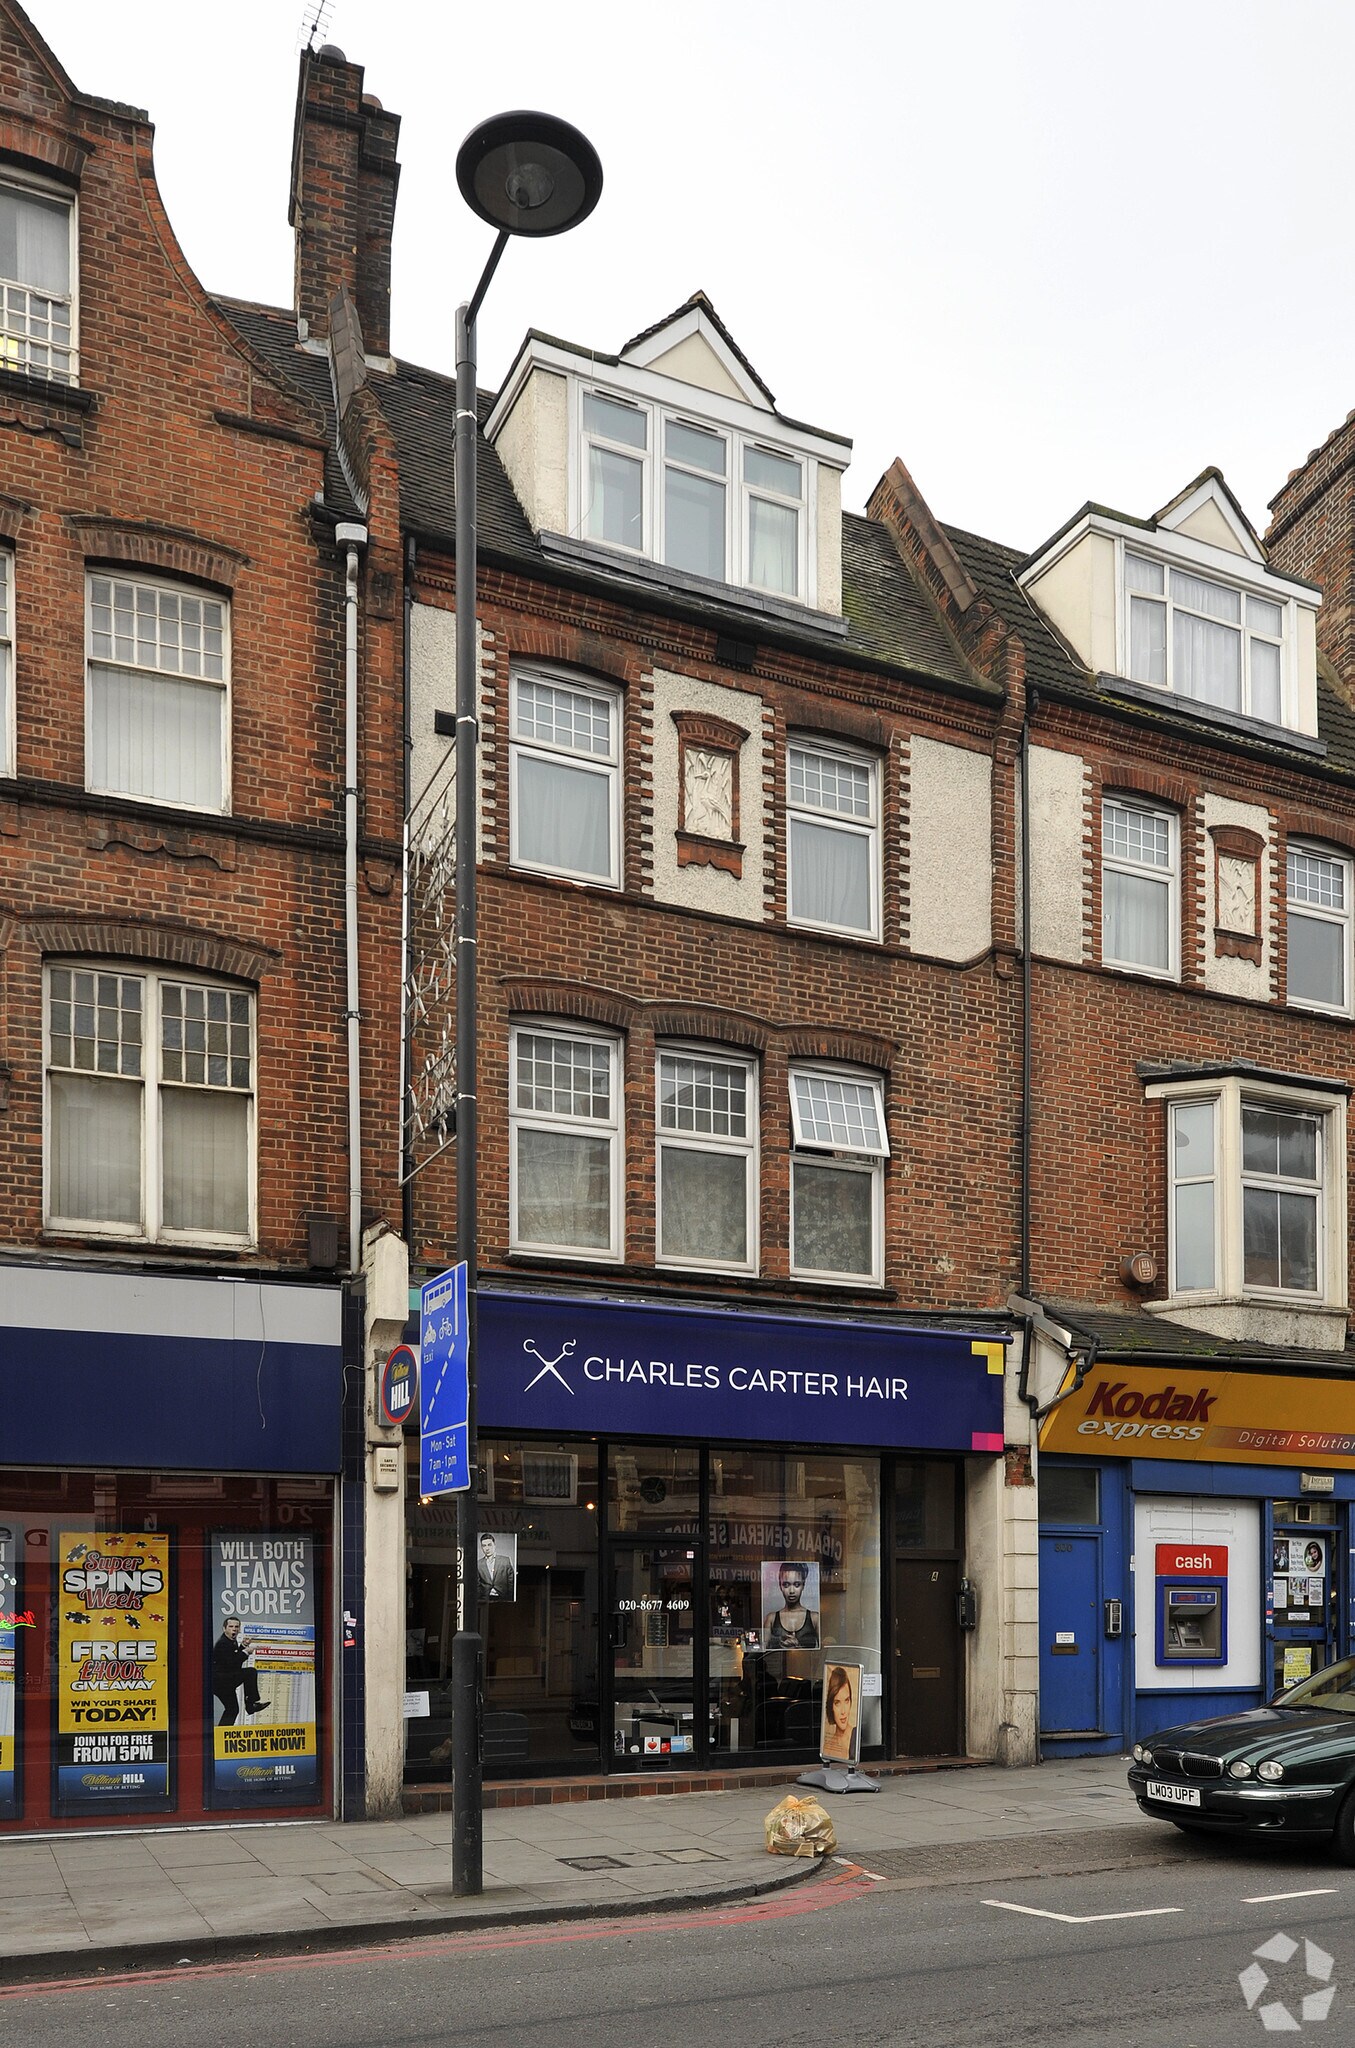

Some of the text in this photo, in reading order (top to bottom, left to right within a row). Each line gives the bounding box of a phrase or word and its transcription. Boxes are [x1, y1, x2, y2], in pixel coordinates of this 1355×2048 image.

[424, 1349, 434, 1364] taxi
[583, 1356, 909, 1401] CHARLES CARTER HAIR
[390, 1380, 410, 1411] HILL
[1085, 1381, 1218, 1422] Kodak
[1077, 1419, 1205, 1441] express
[1238, 1431, 1293, 1447] Digital
[220, 1541, 305, 1560] WILL BOTH
[85, 1552, 143, 1575] Super
[1175, 1553, 1212, 1569] cash
[64, 1570, 163, 1593] SPINS
[220, 1560, 306, 1589] TEAMS
[79, 1587, 143, 1609] Week
[220, 1589, 306, 1615] SCORE?
[619, 1599, 690, 1610] 020-8677 4609
[72, 1641, 157, 1661] FREE
[71, 1680, 156, 1691] GIVEAWAY
[71, 1707, 156, 1722] TODAY!
[73, 1735, 153, 1747] JOIN IN FOR FREE
[224, 1731, 242, 1739] PICK
[255, 1730, 275, 1738] YOUR
[276, 1728, 306, 1737] COUPON
[73, 1745, 153, 1762] FROM 5PM
[224, 1737, 306, 1753] INSIDE NOW!
[122, 1773, 145, 1784] HILL
[275, 1765, 296, 1775] HILL
[1150, 1783, 1195, 1802] LM03 UPF
